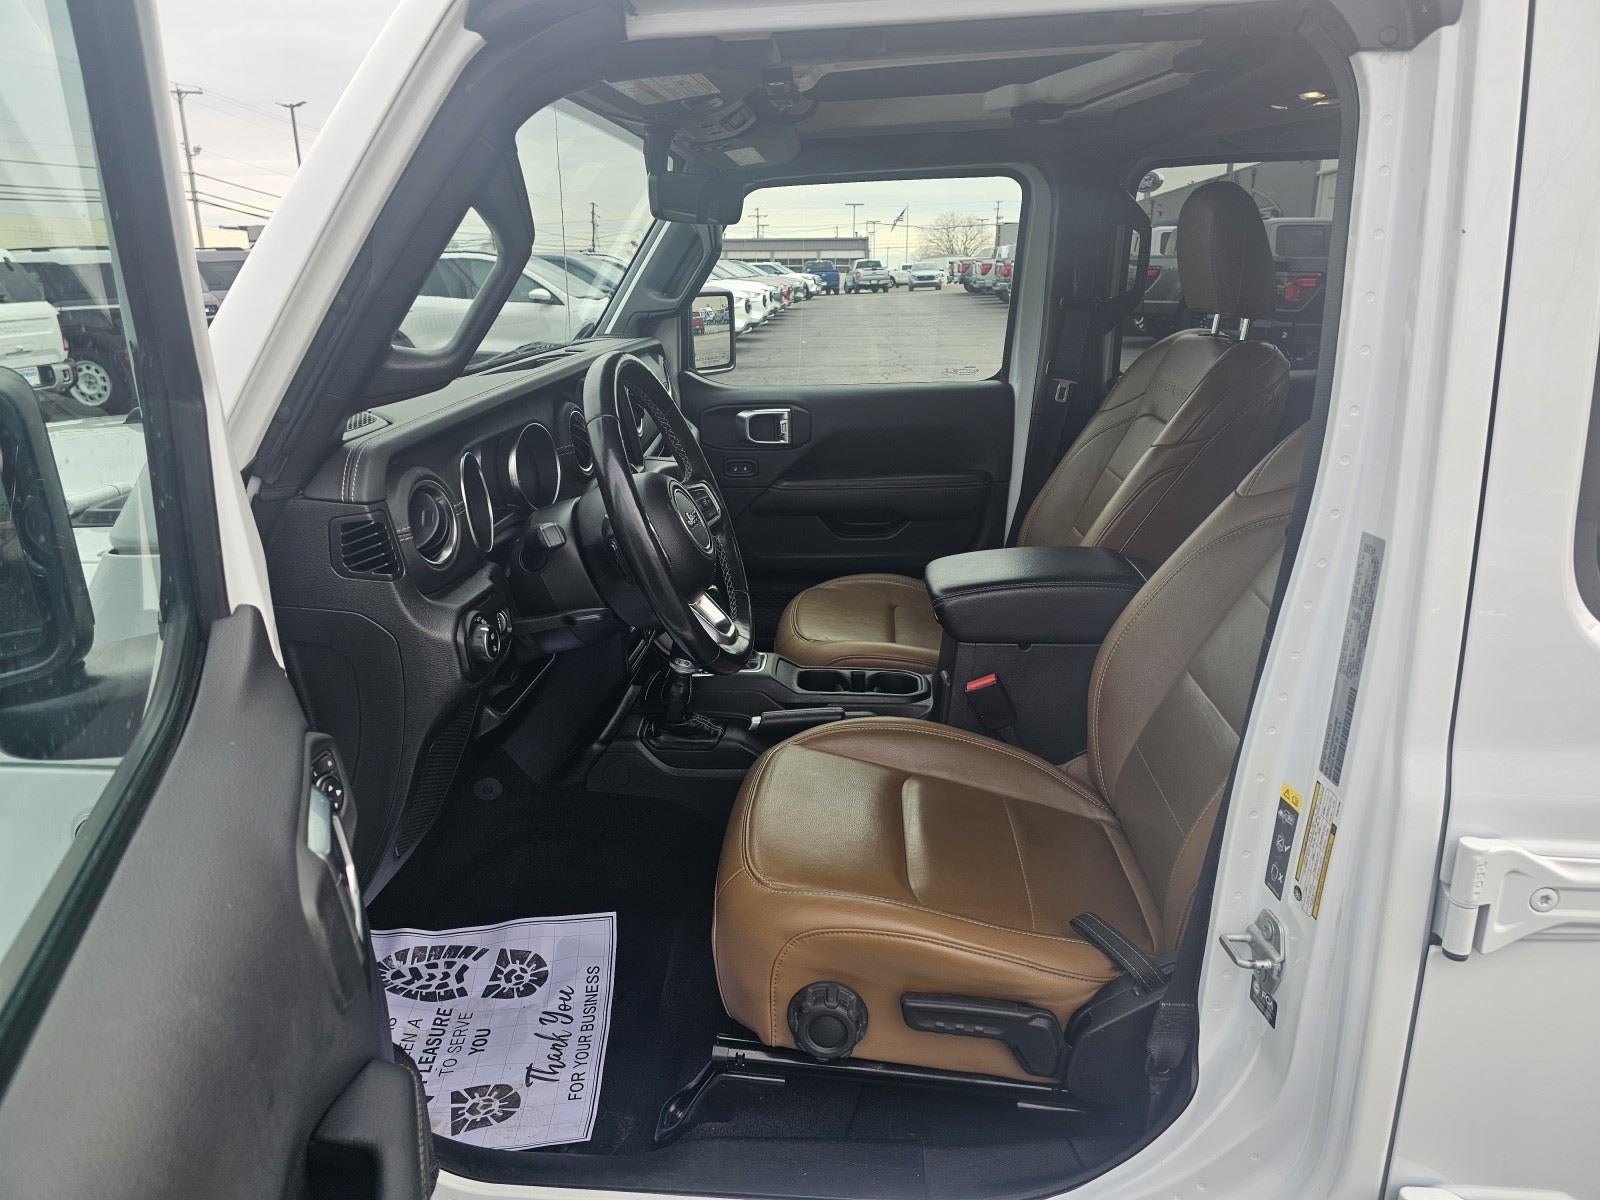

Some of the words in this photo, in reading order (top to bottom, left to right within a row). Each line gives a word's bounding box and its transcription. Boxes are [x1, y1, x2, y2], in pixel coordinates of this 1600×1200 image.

[538, 985, 575, 1026] You
[580, 966, 600, 1032] BUSINESS
[408, 1018, 424, 1029] A
[447, 1011, 474, 1054] SERVE
[468, 1028, 491, 1056] YOU
[417, 1007, 453, 1084] LEASURE
[525, 1030, 572, 1087] Thank
[573, 1034, 593, 1069] YOUR
[438, 1058, 458, 1077] TO
[567, 1071, 586, 1101] FOR
